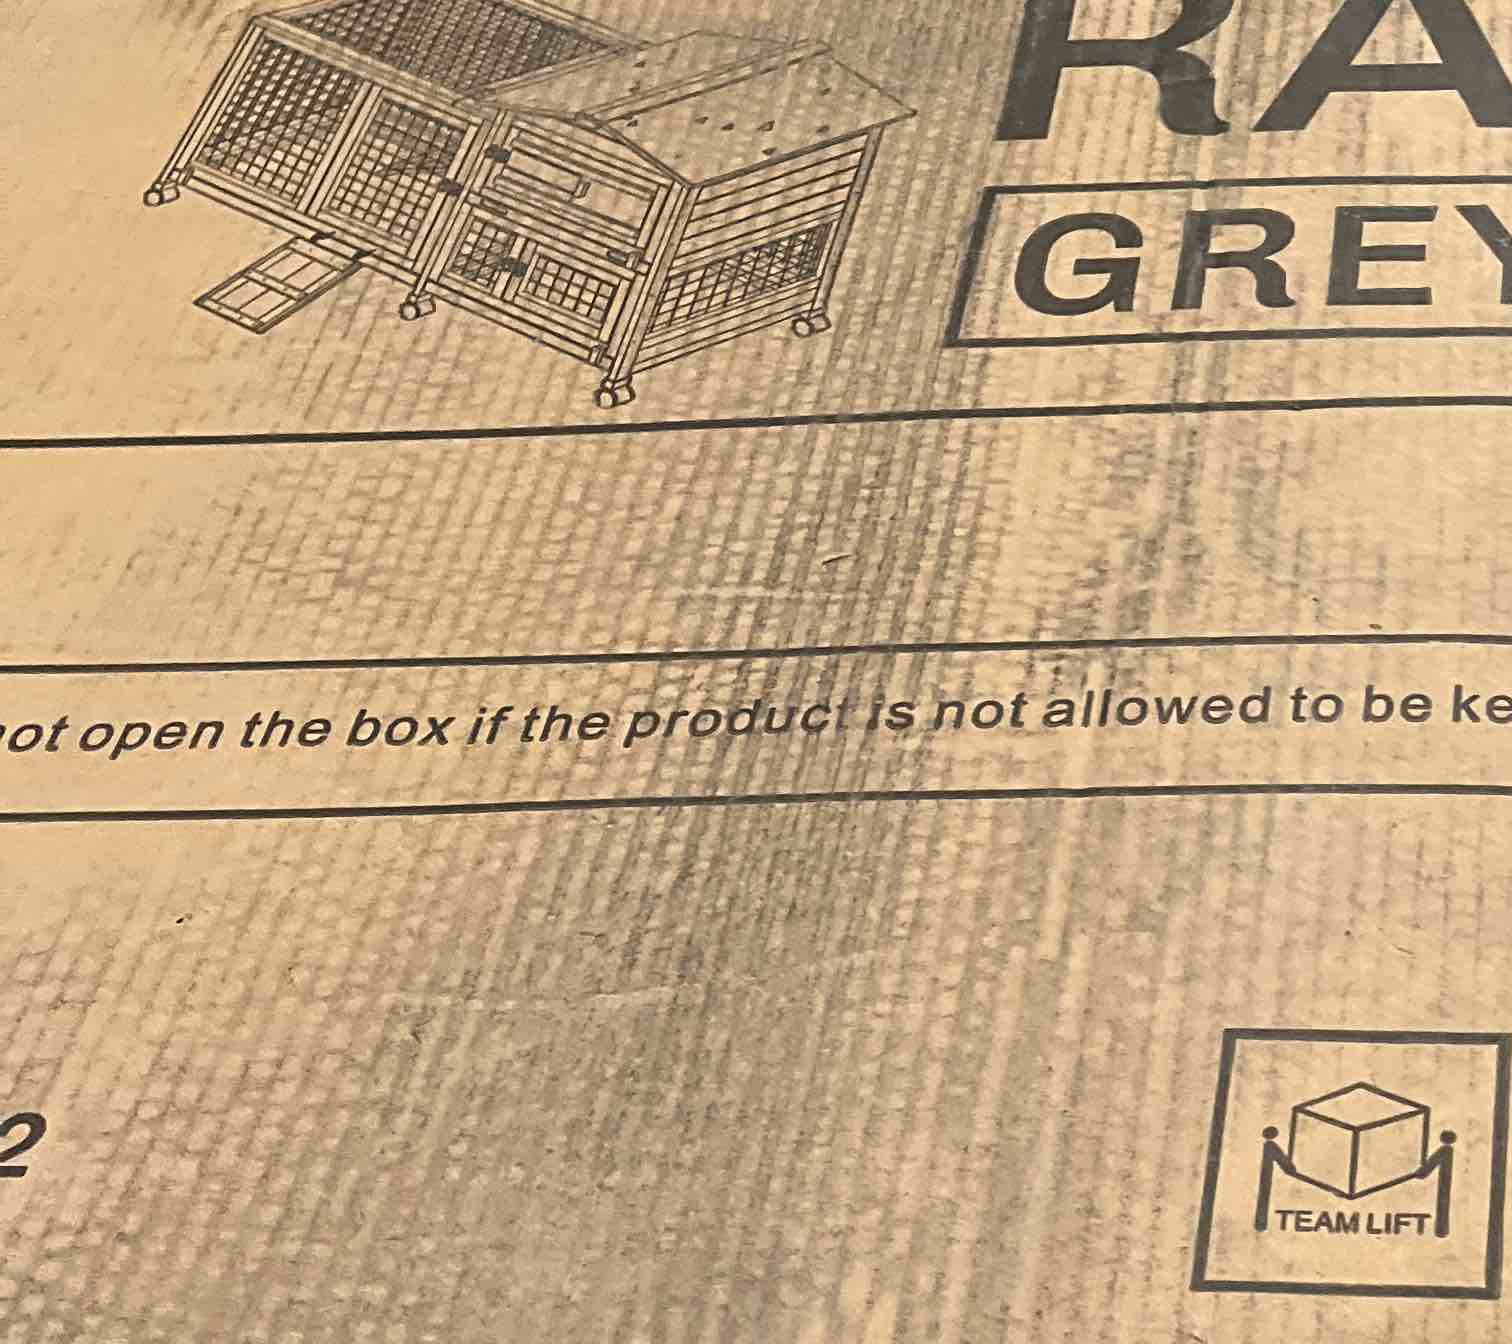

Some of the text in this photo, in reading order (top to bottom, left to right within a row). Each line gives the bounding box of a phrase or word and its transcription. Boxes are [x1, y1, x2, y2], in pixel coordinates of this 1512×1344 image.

[0, 715, 69, 752] ot
[78, 718, 225, 760] open
[241, 709, 331, 749] the
[346, 708, 454, 746] box
[468, 705, 516, 744] if
[521, 705, 611, 742] the
[624, 698, 849, 749] product
[869, 694, 916, 731] is
[932, 692, 1027, 730] not
[1042, 687, 1272, 729] allowed
[1290, 687, 1344, 725] to
[1362, 684, 1432, 724] be
[1275, 1208, 1432, 1237] TEAM LIFT
